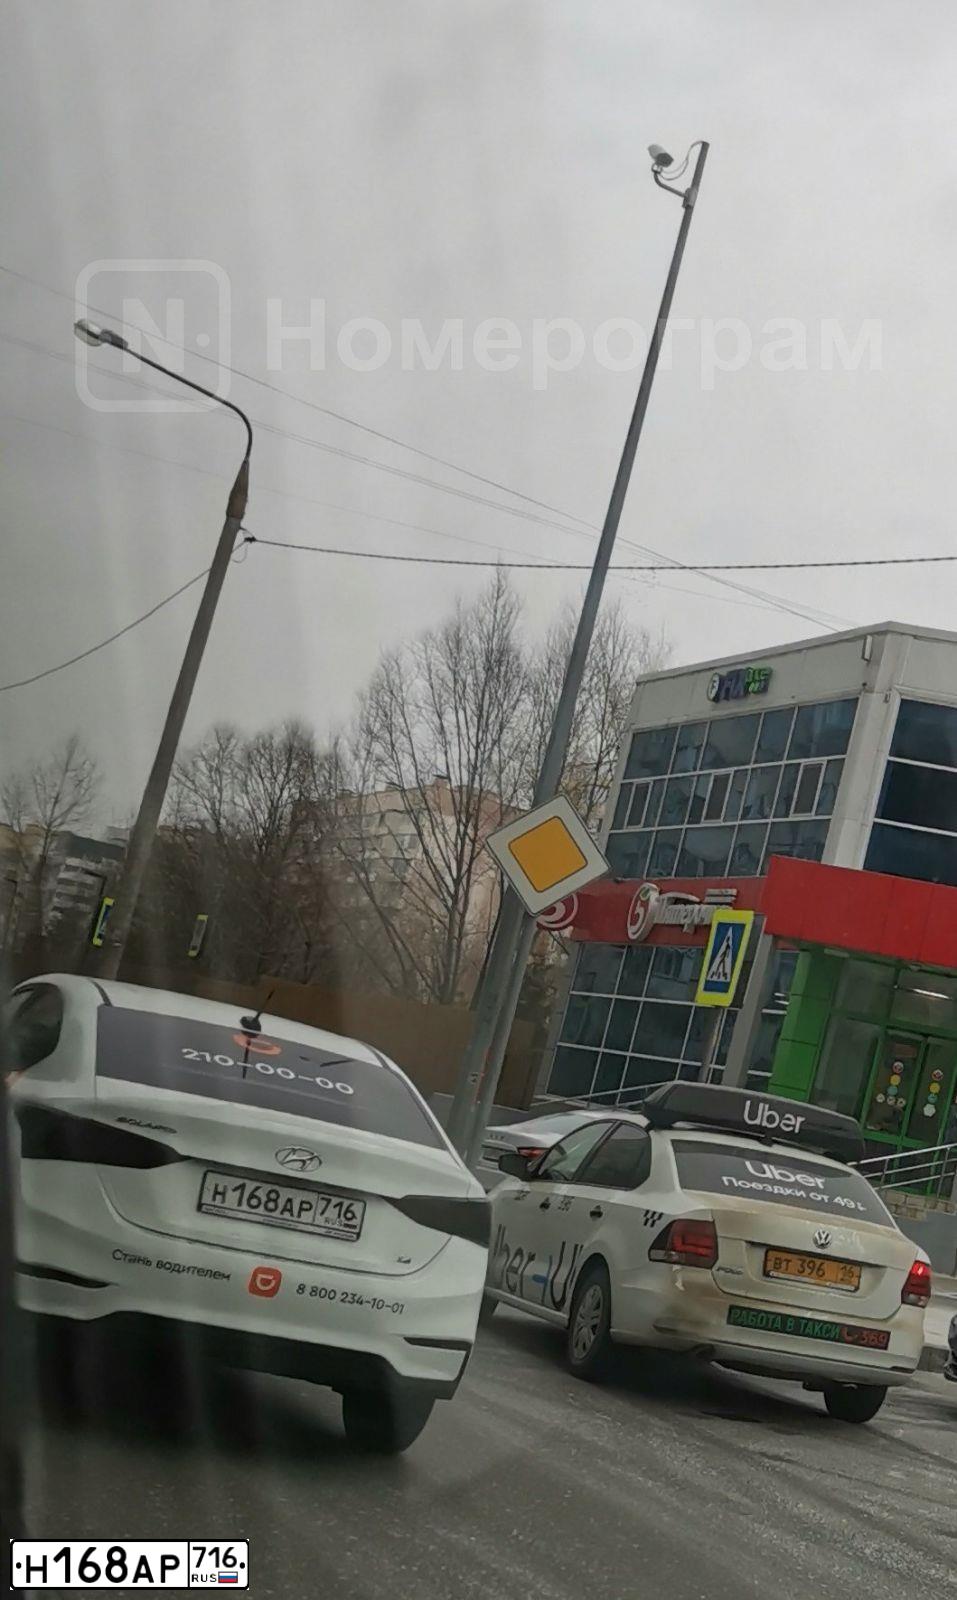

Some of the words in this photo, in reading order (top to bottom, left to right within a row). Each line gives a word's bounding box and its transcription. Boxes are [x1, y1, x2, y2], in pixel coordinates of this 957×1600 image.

[182, 1048, 354, 1095] 210-00-00
[743, 1100, 806, 1133] Uber
[721, 1176, 807, 1199] Поездки
[809, 1192, 830, 1203] от
[744, 1161, 825, 1189] Uber
[112, 1248, 153, 1267] Стань
[155, 1260, 232, 1281] водителем
[797, 1258, 826, 1278] 396
[296, 1283, 307, 1296] 8
[309, 1286, 337, 1300] 800
[340, 1291, 405, 1315] 234-10-01
[730, 1308, 783, 1331] РАБОТА
[786, 1320, 796, 1333] В
[799, 1319, 841, 1340] ТАКСИ
